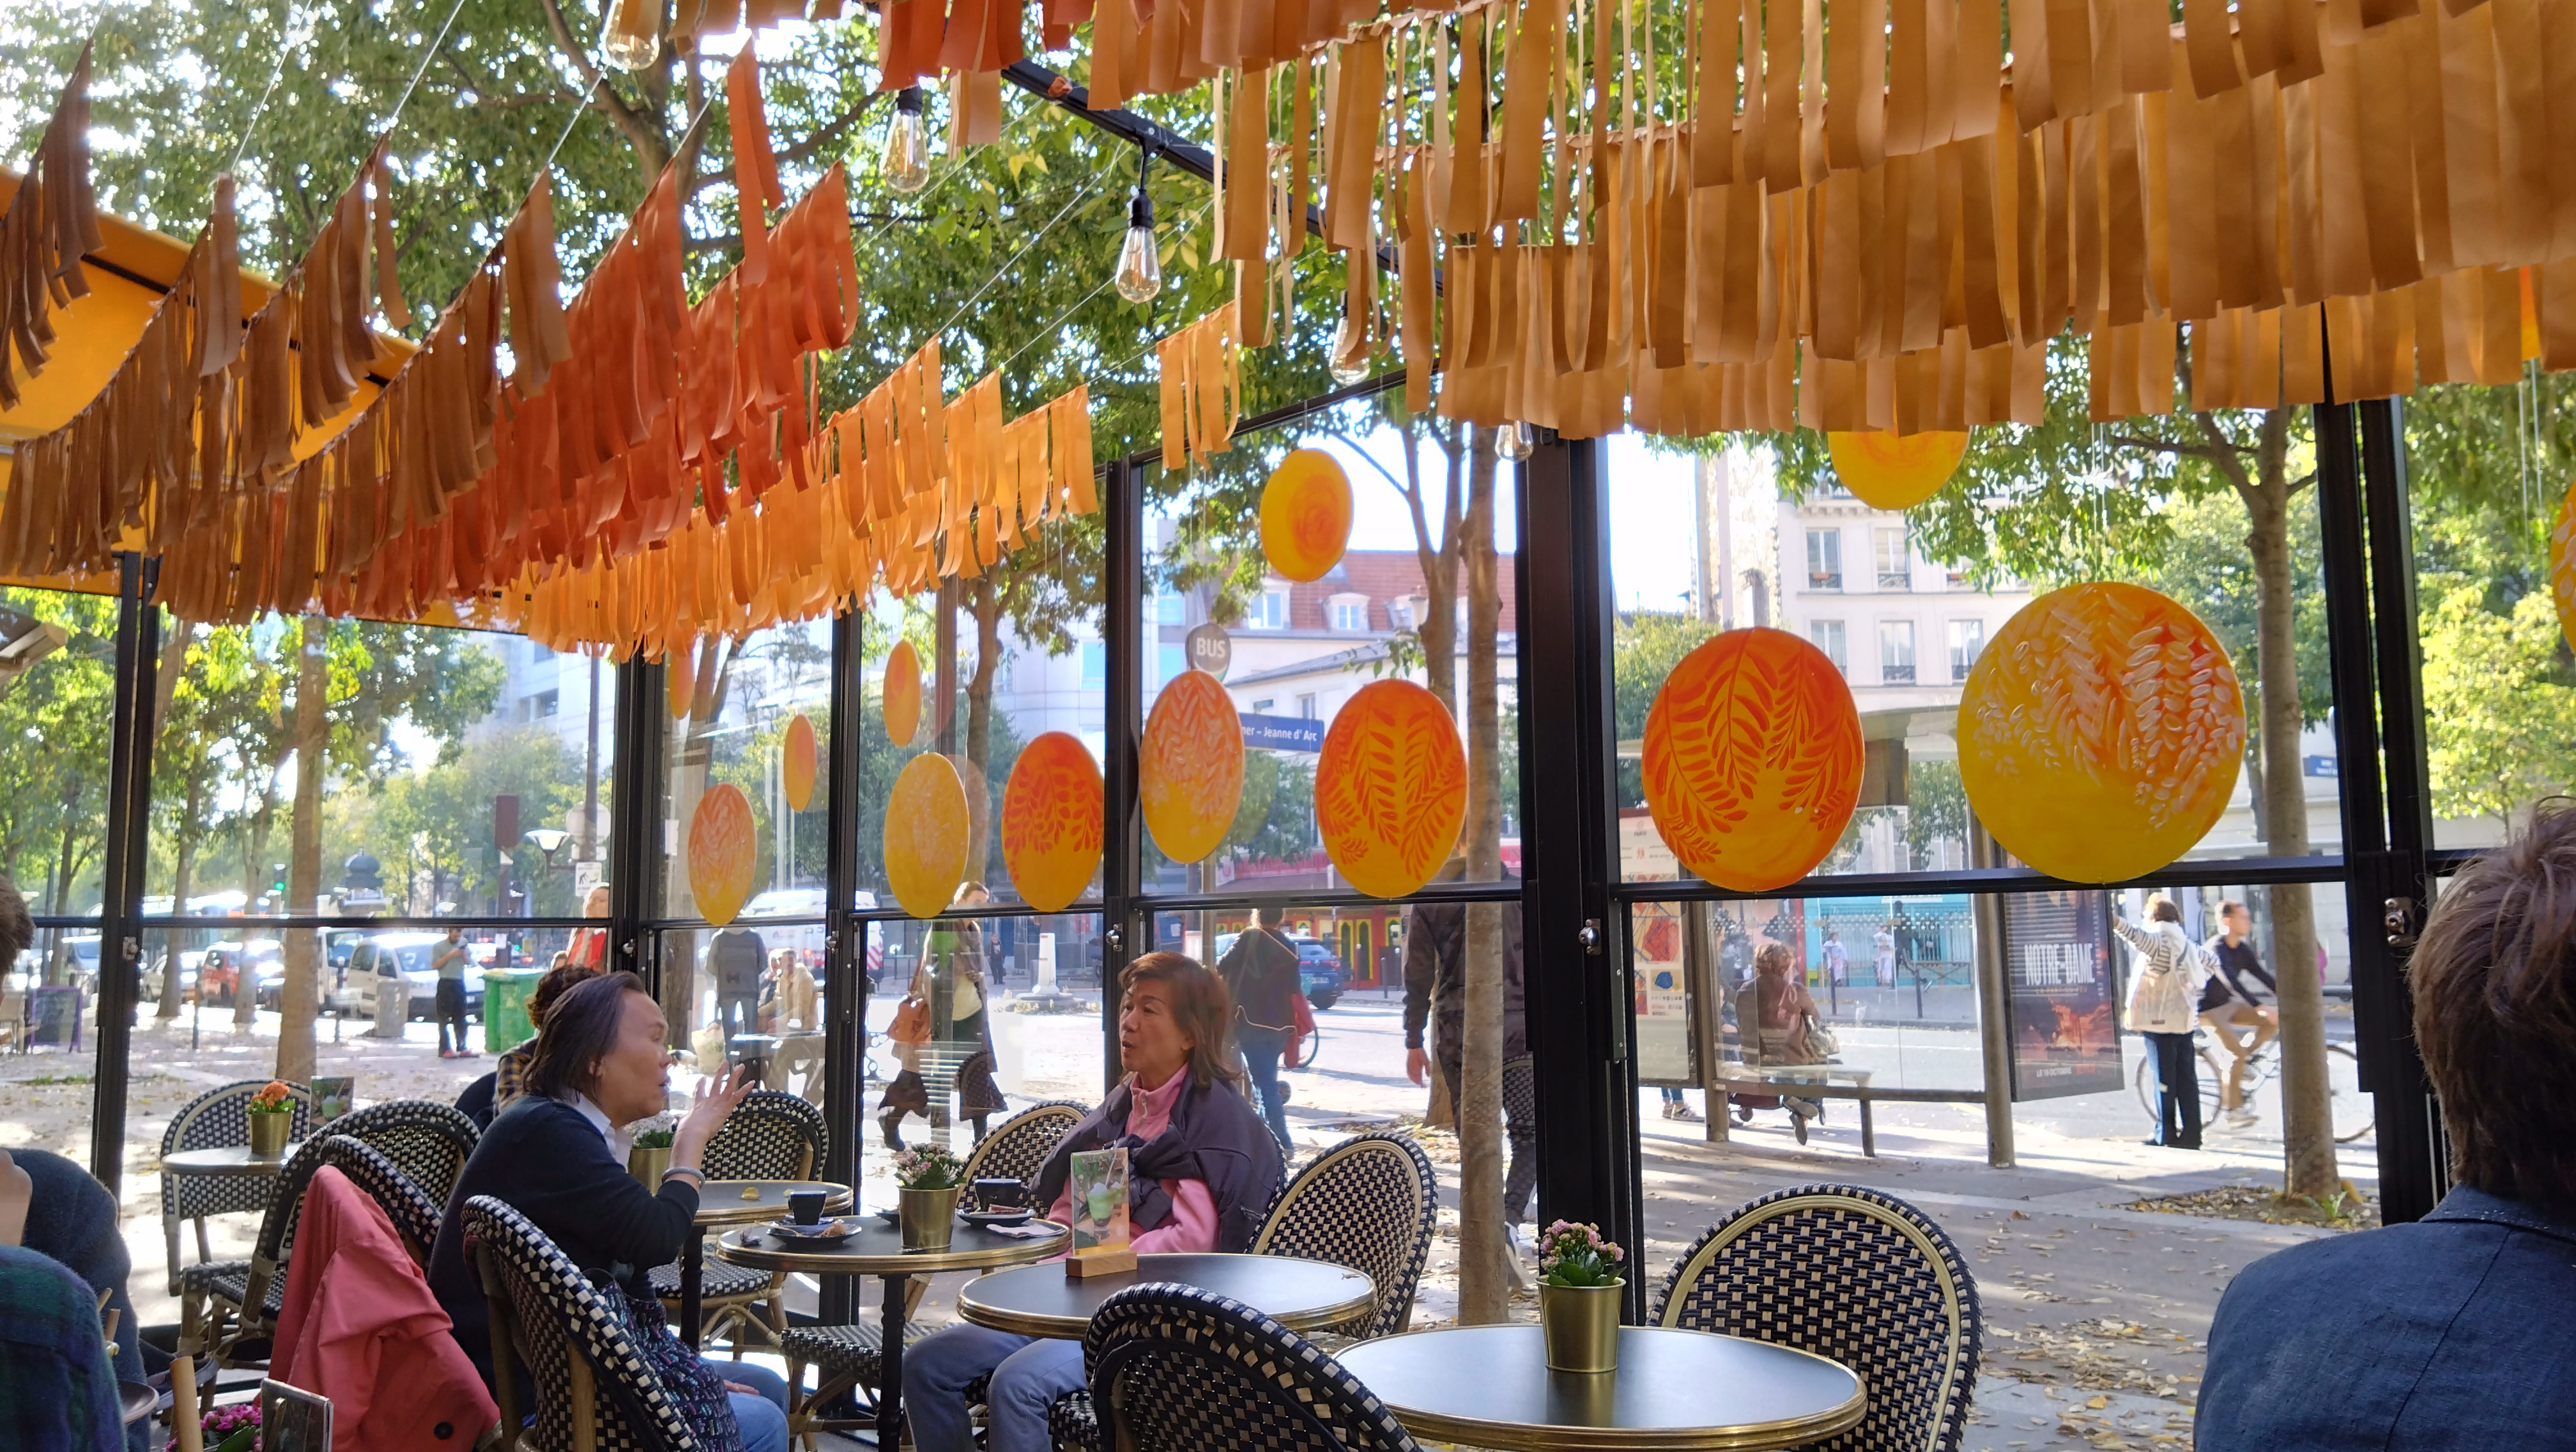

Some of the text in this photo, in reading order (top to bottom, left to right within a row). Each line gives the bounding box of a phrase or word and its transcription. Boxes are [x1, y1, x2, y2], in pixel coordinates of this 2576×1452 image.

[1196, 637, 1226, 658] BUS
[1263, 726, 1292, 739] Jeanne
[1303, 730, 1317, 742] Arc
[2024, 943, 2096, 986] NOTRE-DAME
